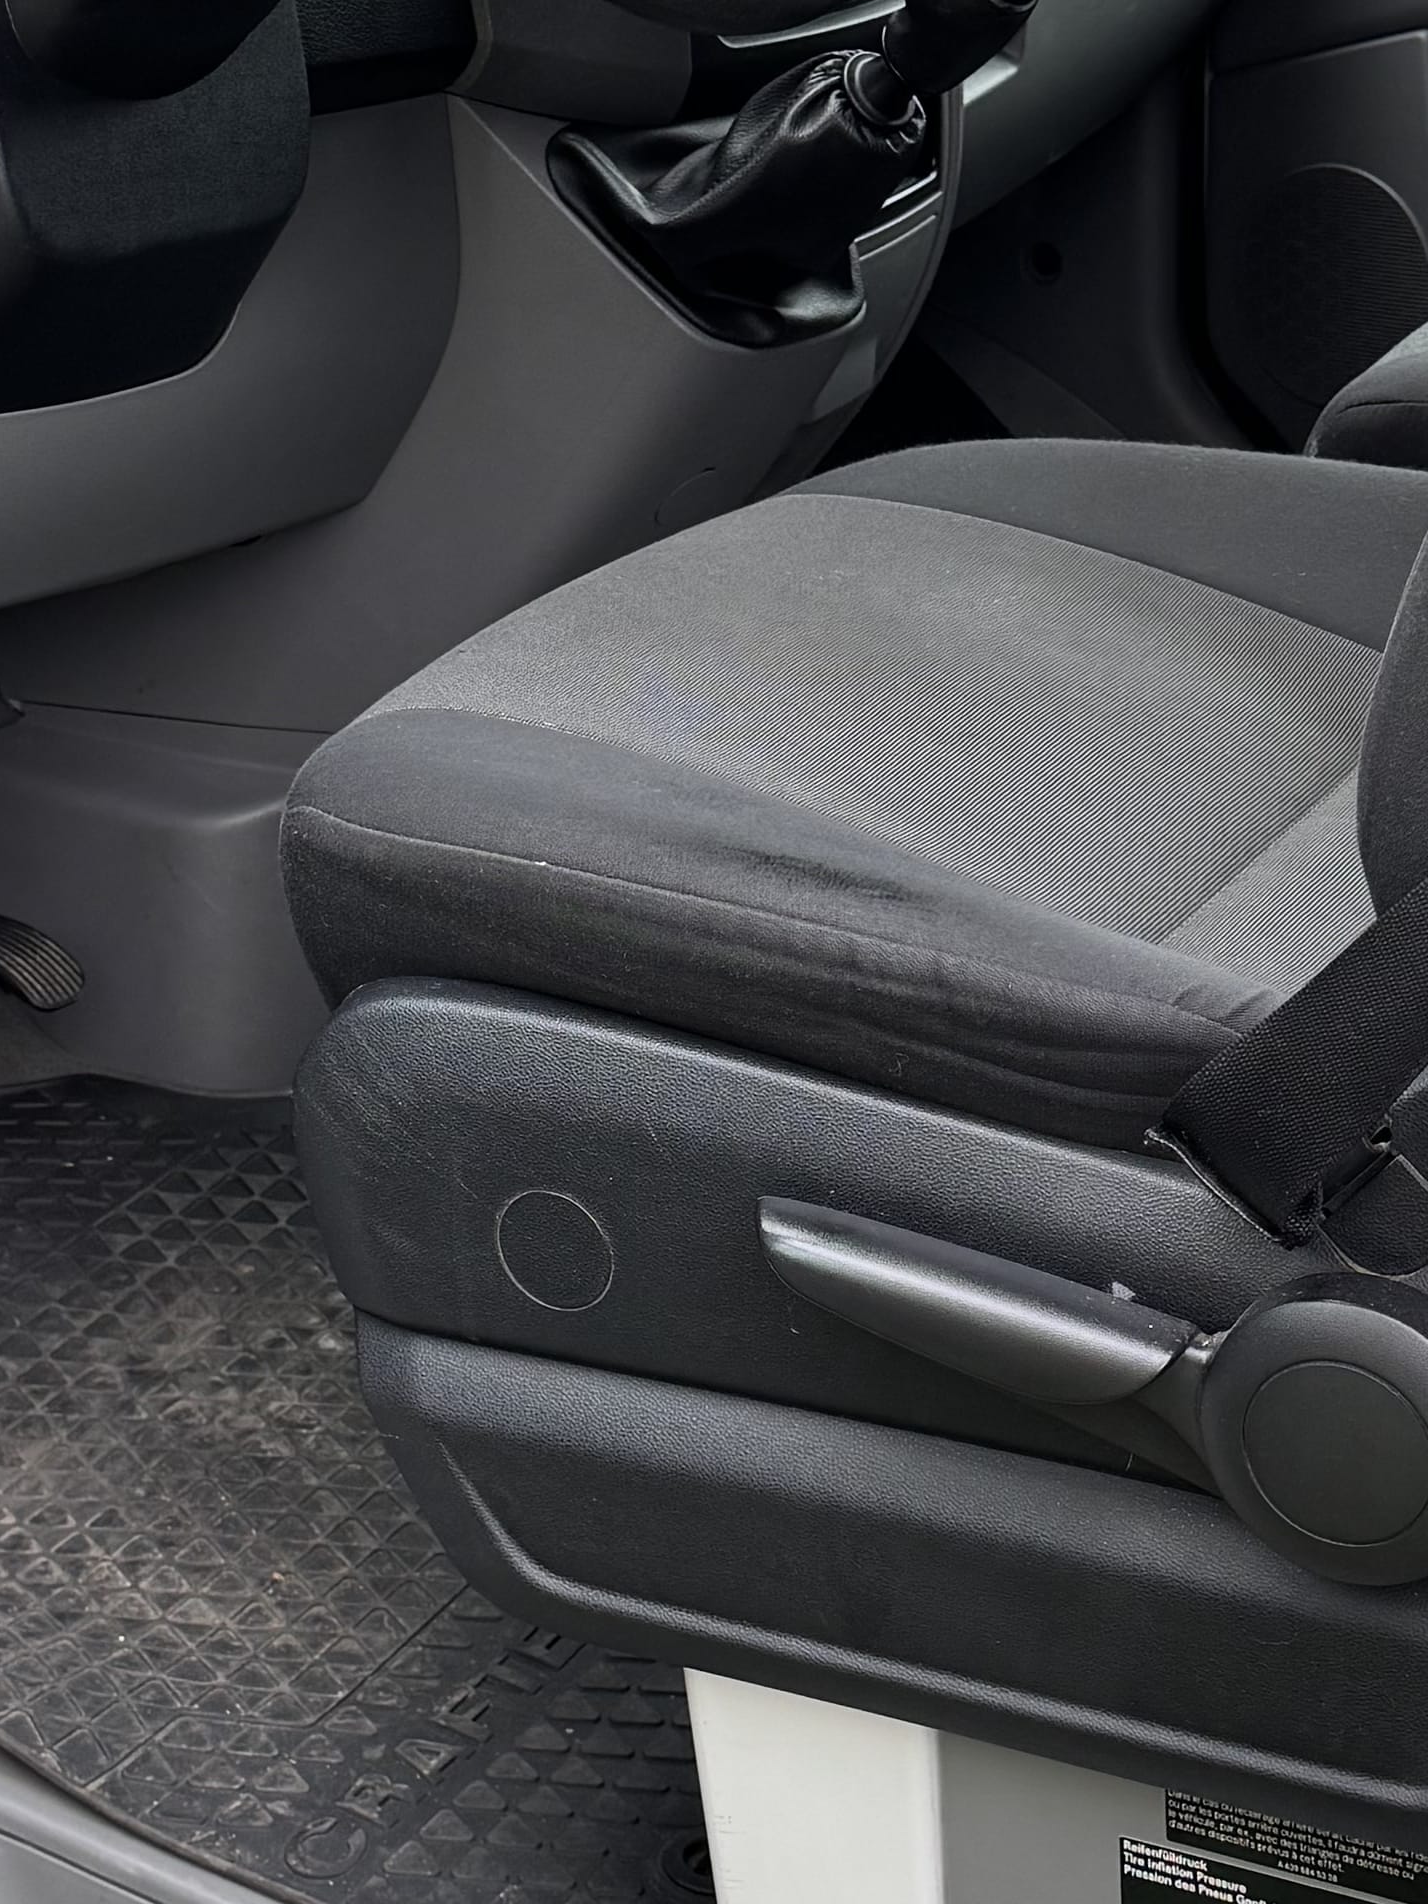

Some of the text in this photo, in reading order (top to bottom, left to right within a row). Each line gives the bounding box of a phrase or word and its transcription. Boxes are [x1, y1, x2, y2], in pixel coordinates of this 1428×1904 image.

[1123, 1839, 1208, 1871] Reifenfülldruck
[1123, 1851, 1247, 1894] Tire Inflation Pressure
[1124, 1864, 1172, 1887] Pression
[1174, 1880, 1196, 1892] des
[1198, 1884, 1233, 1903] Pneus
